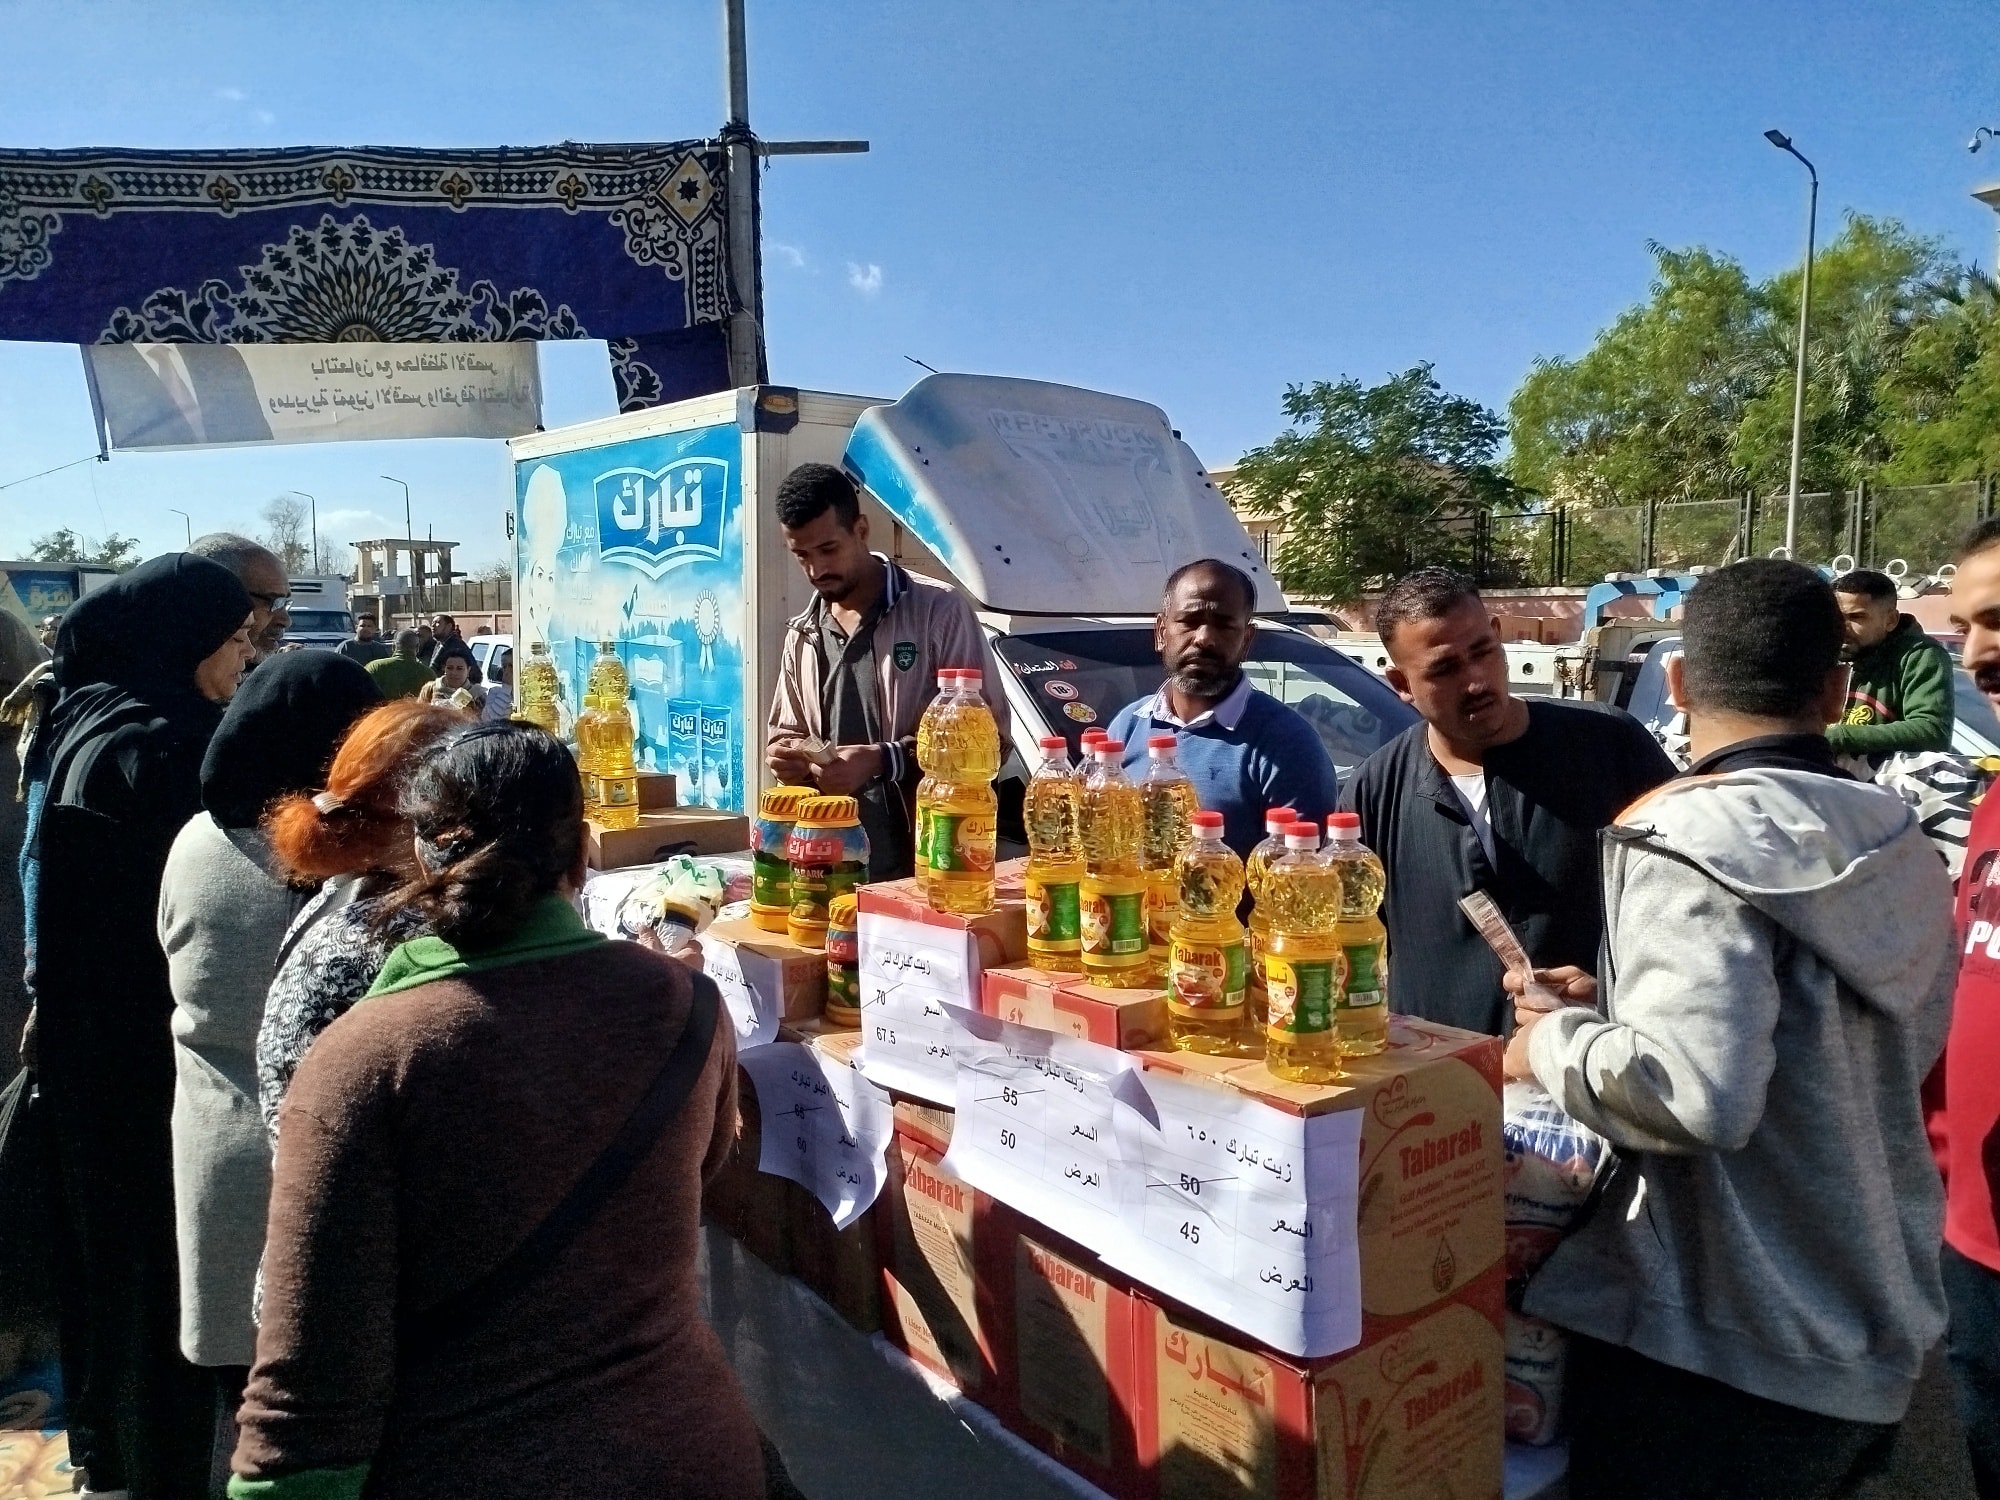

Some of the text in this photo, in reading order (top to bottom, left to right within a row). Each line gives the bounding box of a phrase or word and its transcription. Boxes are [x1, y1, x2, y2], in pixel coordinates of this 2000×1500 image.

[612, 468, 702, 546] تبارك
[672, 715, 694, 734] تبارك
[703, 719, 724, 739] تبارك
[789, 839, 832, 860] تبارك
[892, 952, 914, 971] تبارك
[913, 957, 931, 975] زيت
[1174, 945, 1221, 968] Tabarak
[876, 989, 886, 1006] 70
[876, 1026, 896, 1045] 67.5
[1064, 1071, 1084, 1093] زيت
[1002, 1085, 1098, 1143] السعر 55
[1000, 1128, 1101, 1189] العرض 50
[1225, 1137, 1259, 1167] تبارك
[1400, 1119, 1482, 1182] Tabarak
[1263, 1157, 1293, 1183] زيت
[1179, 1173, 1314, 1239] السعر 50
[1179, 1221, 1314, 1293] العرض 45
[1028, 1244, 1096, 1303] Tabarak
[1165, 1331, 1266, 1407] تبارك
[1404, 1359, 1484, 1433] Tabarak
